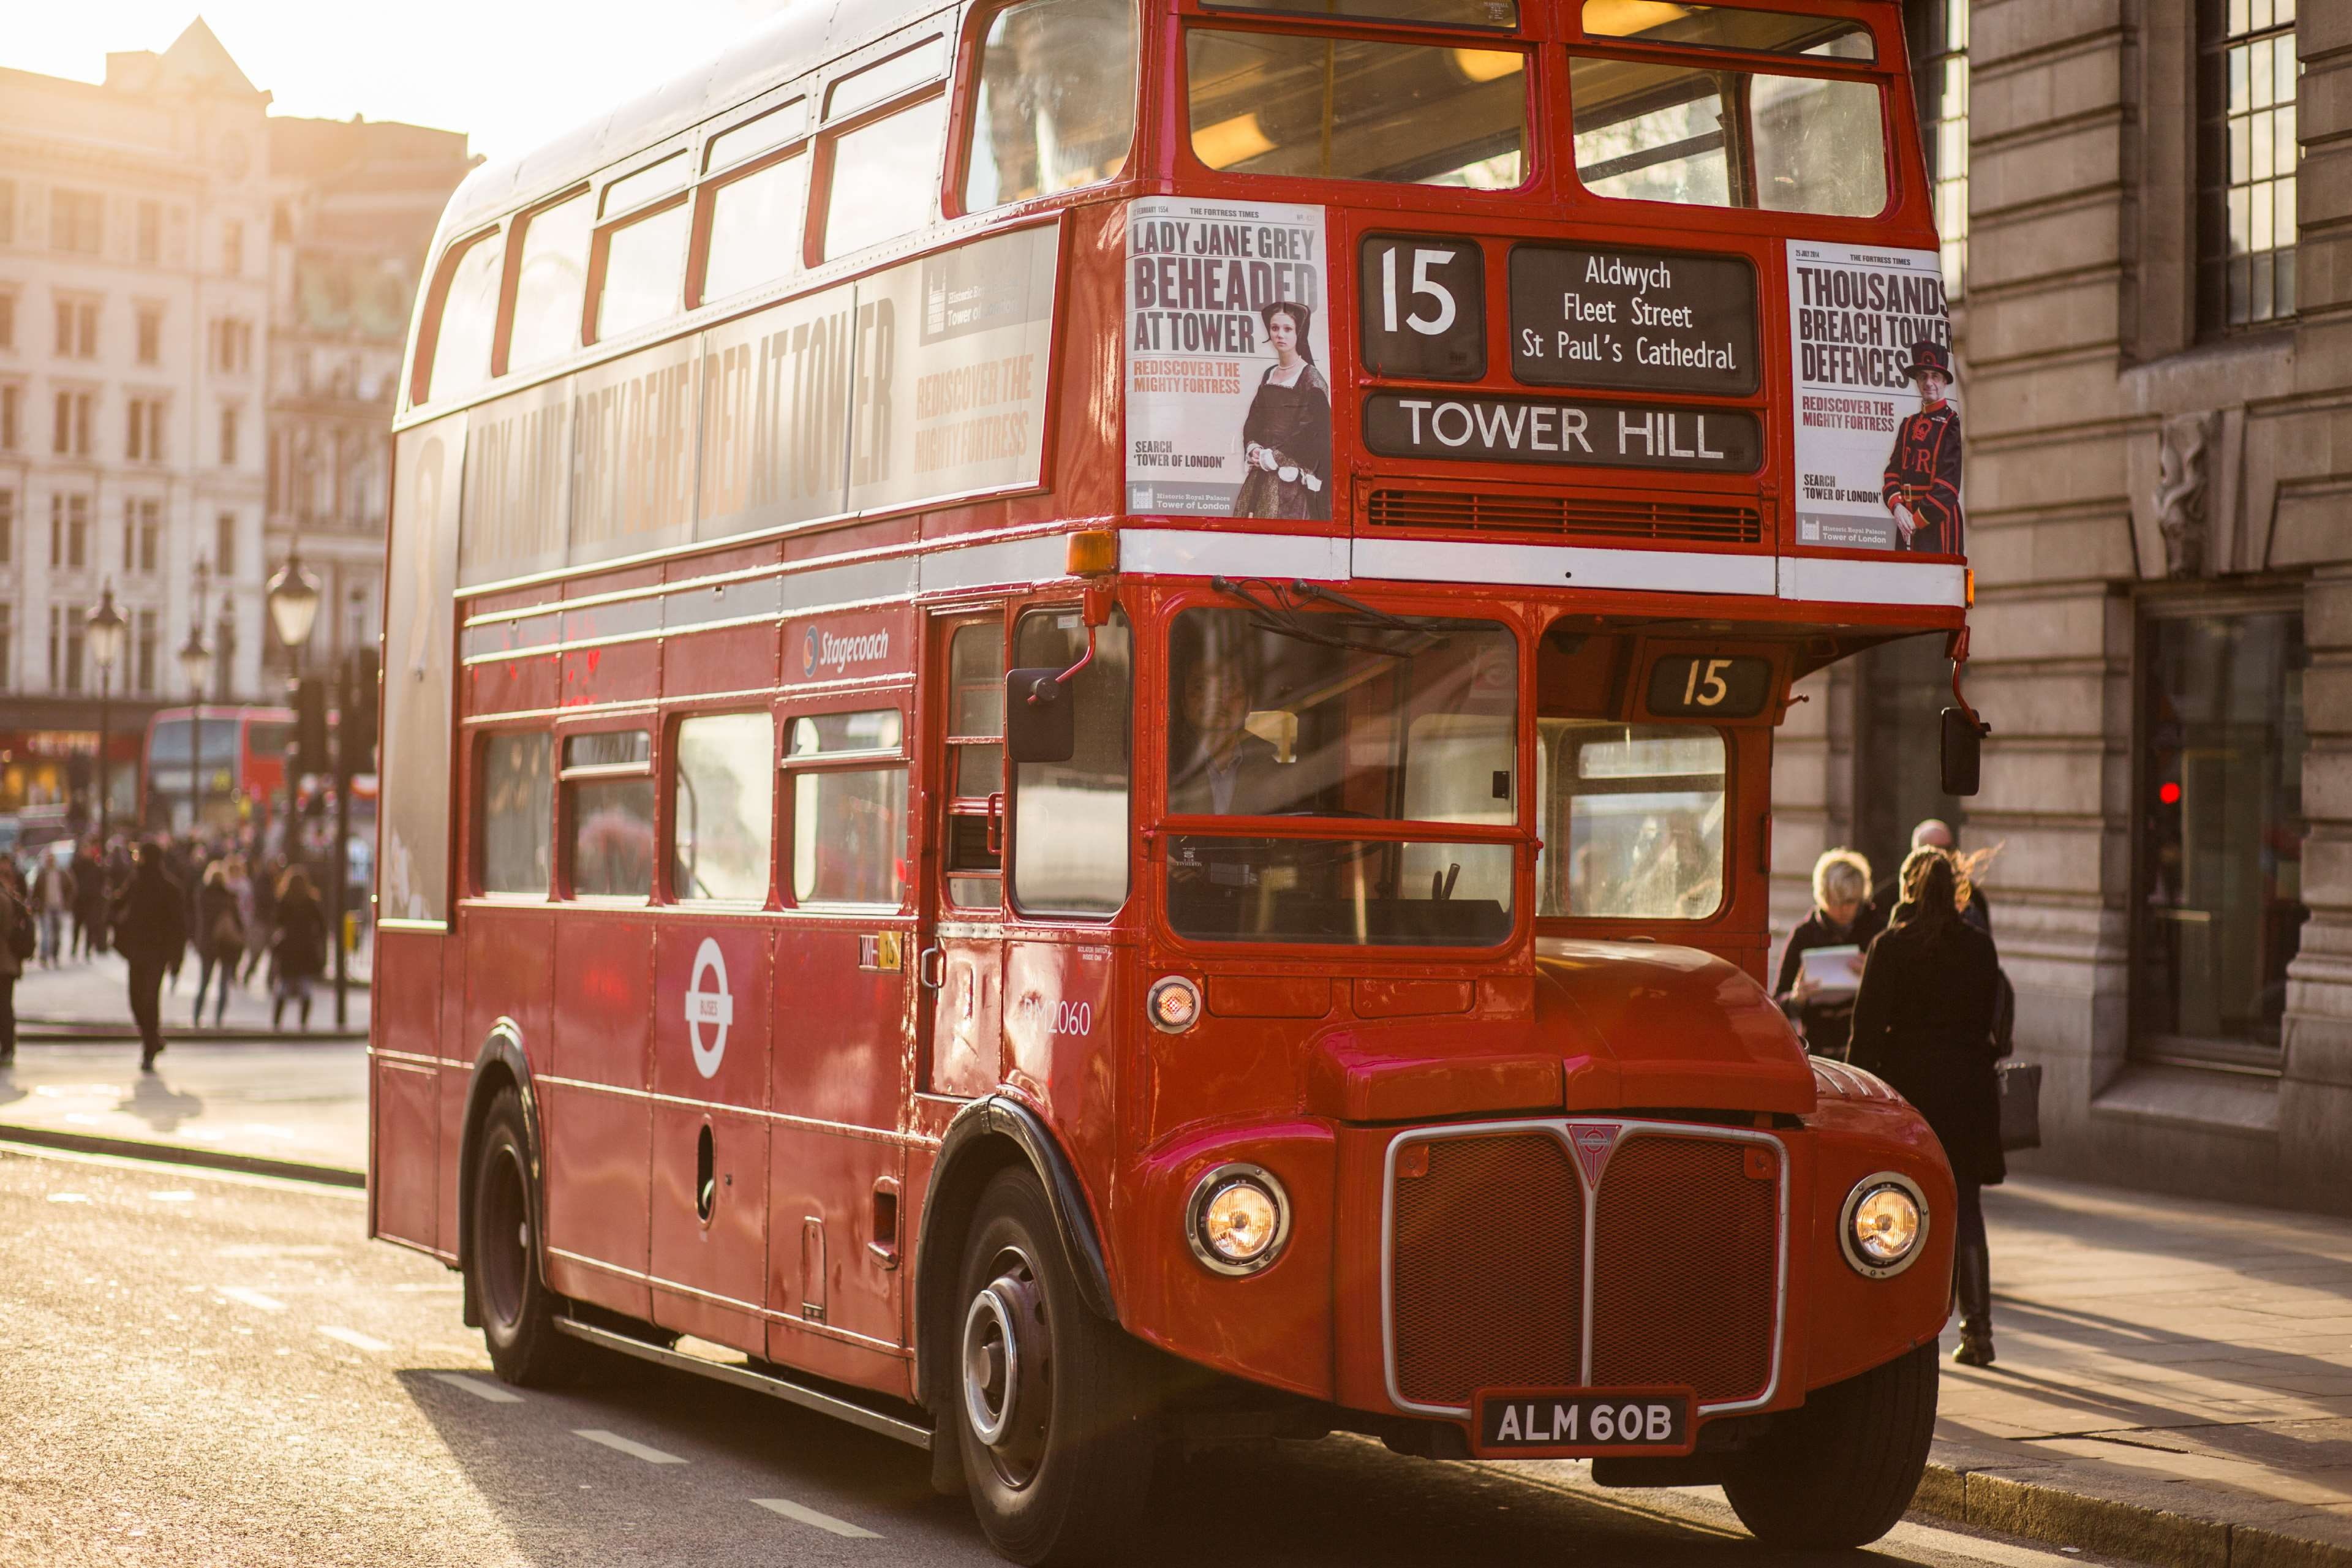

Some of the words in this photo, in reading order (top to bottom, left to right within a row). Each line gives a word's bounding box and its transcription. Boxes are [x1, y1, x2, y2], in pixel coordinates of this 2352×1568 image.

[1204, 208, 1237, 217] FORTRESS
[1133, 221, 1190, 255] LADY
[1193, 224, 1253, 257] JANE
[1257, 227, 1315, 261] GREY
[1585, 255, 1671, 295] Aldwych
[1862, 255, 1891, 264] FORTRESS
[1893, 257, 1911, 266] TIMES
[948, 288, 973, 304] Historic
[1134, 257, 1317, 314] BEHEADED
[1382, 246, 1457, 335] 15
[1796, 267, 1949, 318] THOUSANDS
[947, 309, 972, 326] Tower
[973, 301, 982, 320] of
[1564, 292, 1616, 325] Fleet
[1630, 297, 1693, 328] Street
[1799, 308, 1883, 346] BREACH
[1134, 312, 1163, 352] AT
[1167, 312, 1256, 353] TOWER
[1522, 328, 1544, 358] St
[1557, 331, 1623, 363] Paul's
[1636, 336, 1737, 371] Cathedral
[1134, 361, 1213, 377] REDISCOVER
[1215, 363, 1240, 377] THE
[1801, 342, 1910, 390] DEFENCES
[916, 361, 999, 421] REDISCOVER
[1001, 353, 1034, 403] THE
[1134, 377, 1181, 393] MIGHTY
[1183, 378, 1240, 394] FORTRESS
[624, 342, 752, 535] BEHEADED
[750, 328, 789, 510] AT
[789, 297, 895, 500] TOWER
[1802, 395, 1871, 415] REDISCOVER
[1873, 401, 1894, 417] THE
[1802, 412, 1845, 429] MIGHTY
[1845, 414, 1894, 432] FORTRESS
[913, 422, 961, 475] MIGHTY
[960, 410, 1030, 465] FORTRESS
[1135, 440, 1172, 453] SEARCH
[1399, 400, 1593, 453] TOWER
[1618, 411, 1724, 459] HILL
[1171, 454, 1183, 467] OF
[1804, 474, 1836, 487] SEARCH
[1835, 489, 1845, 501] OF
[1858, 534, 1887, 544] London
[820, 627, 889, 674] Stagecoach
[1684, 660, 1733, 706] 15
[1024, 997, 1091, 1036] RM2060
[1496, 1404, 1579, 1441] ALM
[1589, 1404, 1672, 1441] 60B
